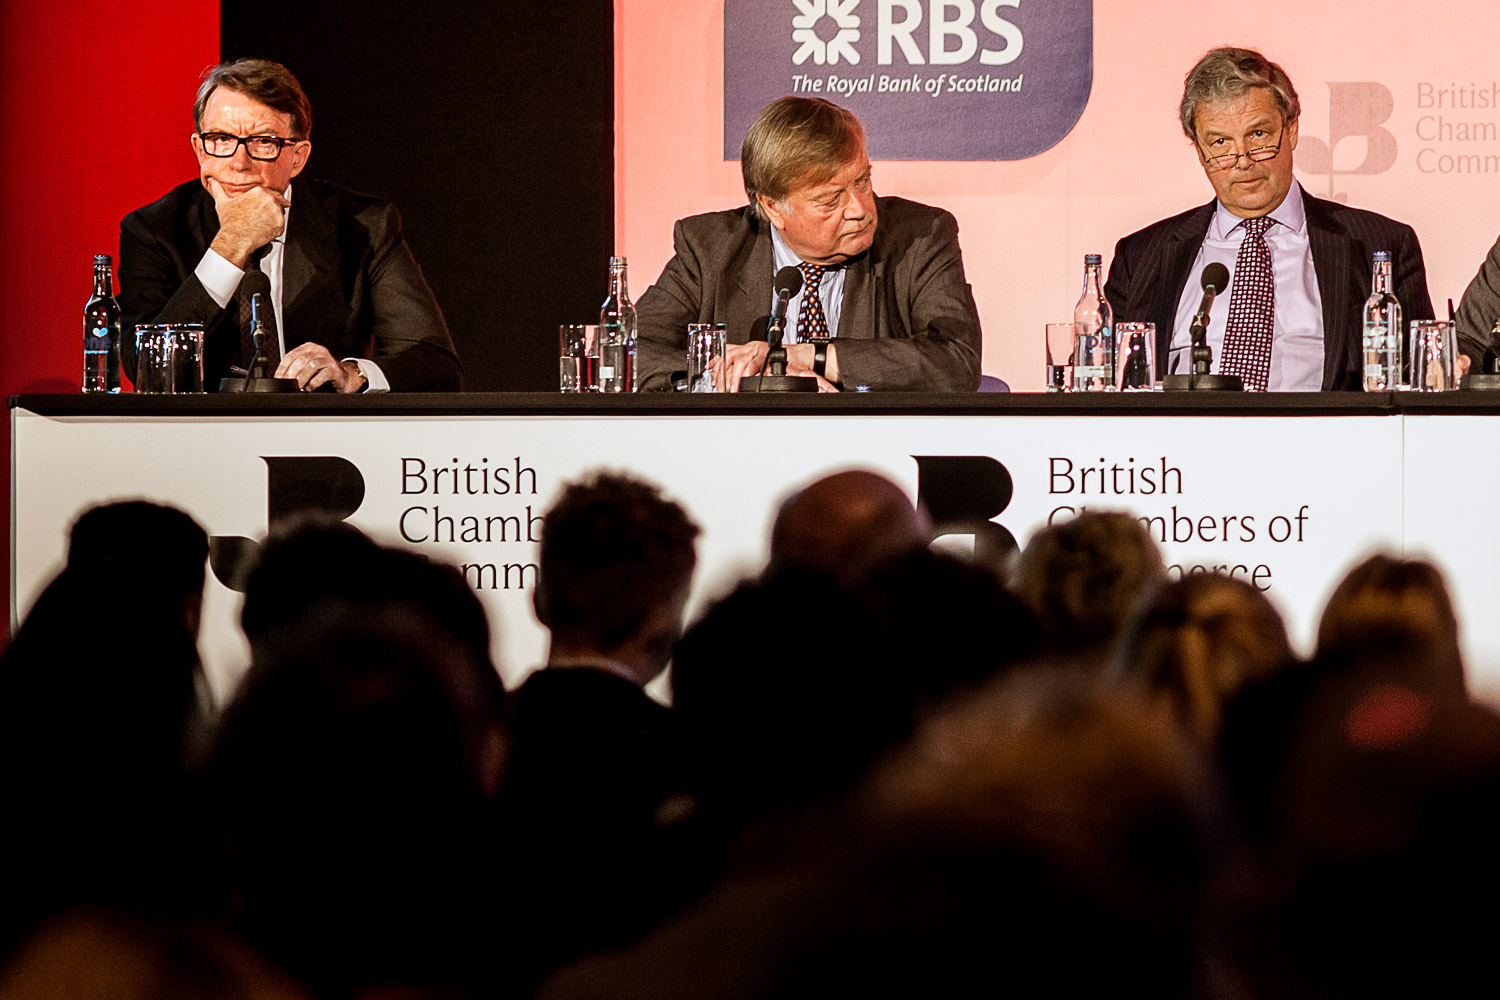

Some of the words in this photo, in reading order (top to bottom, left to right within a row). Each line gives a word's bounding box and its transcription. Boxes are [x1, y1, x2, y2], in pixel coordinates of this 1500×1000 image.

[792, 74, 822, 93] The
[826, 74, 874, 98] Royal
[877, 74, 921, 93] Bank
[924, 74, 946, 98] of
[948, 74, 1024, 93] Scotland
[400, 456, 538, 495] British
[1048, 456, 1183, 495] British
[399, 505, 547, 544] Chamb
[1048, 505, 1257, 543] mbers
[1268, 505, 1309, 543] of
